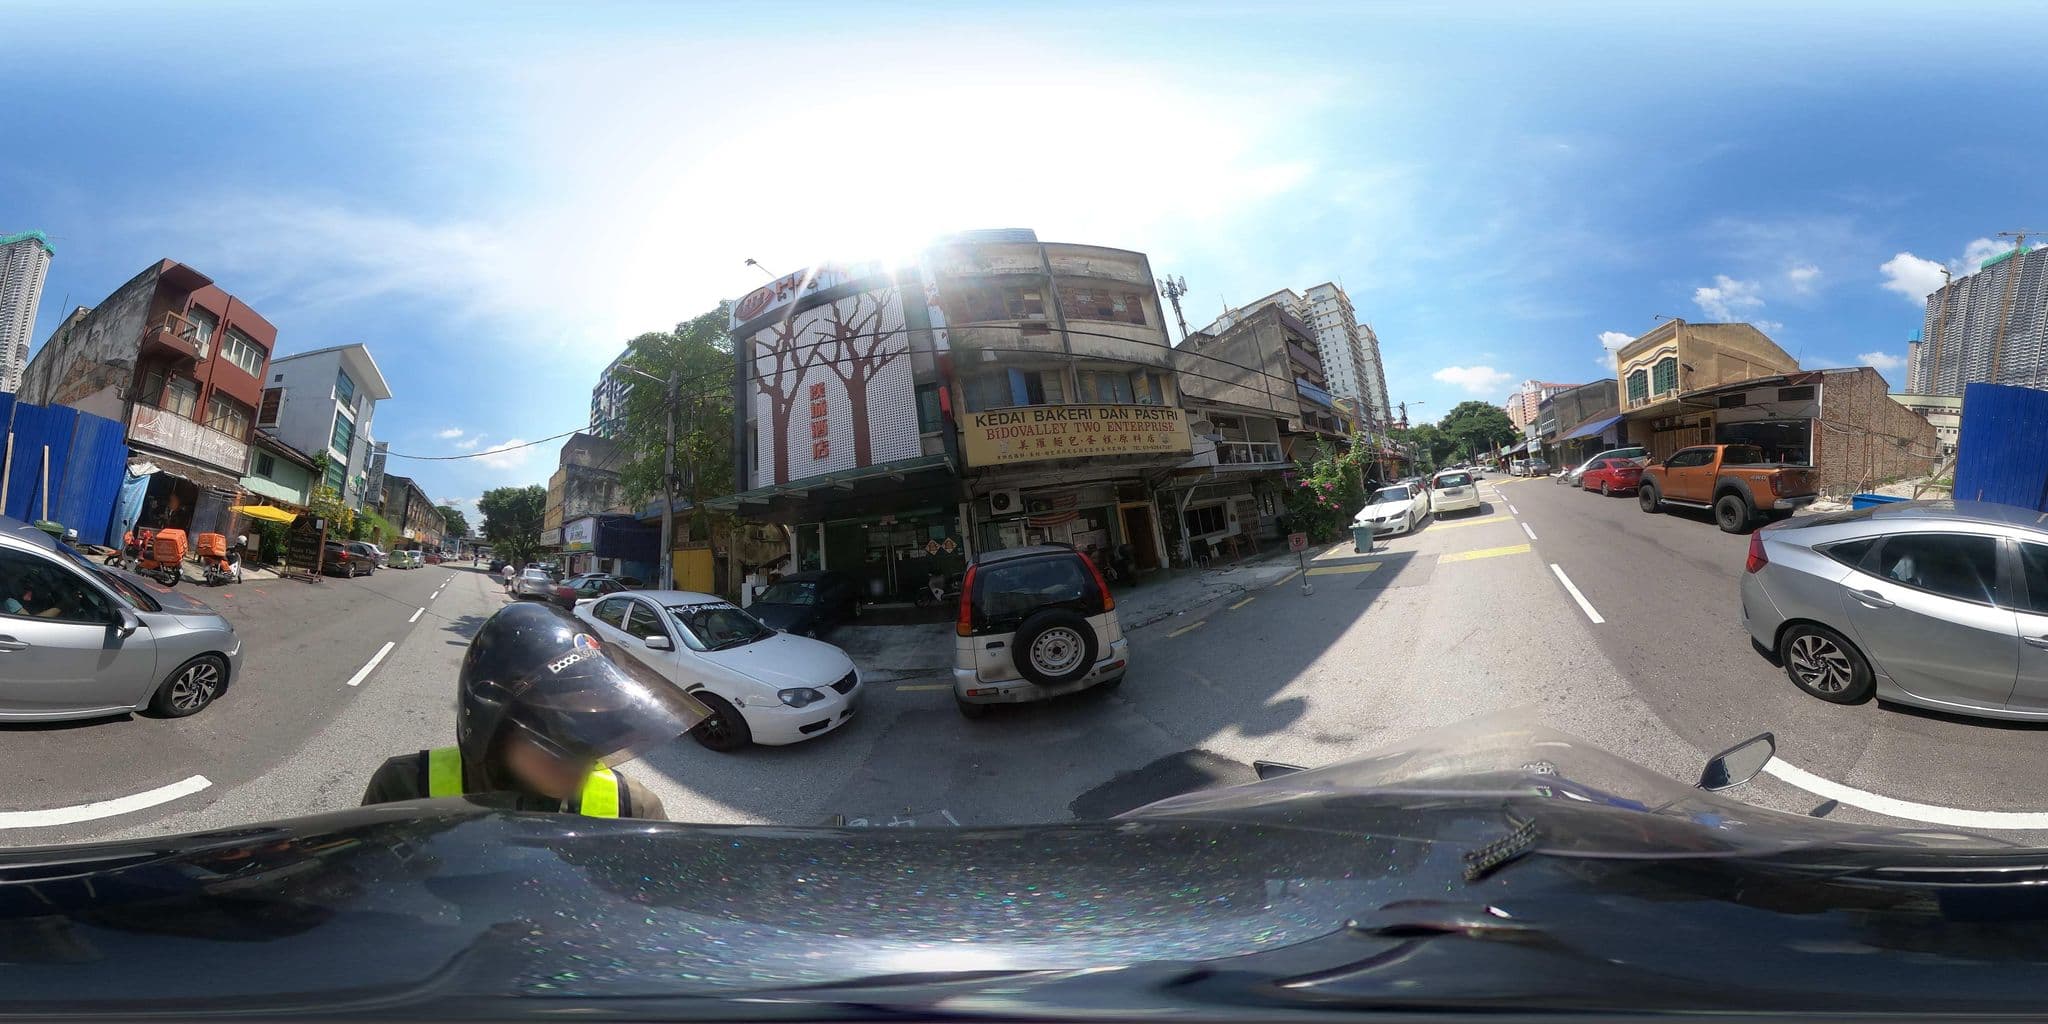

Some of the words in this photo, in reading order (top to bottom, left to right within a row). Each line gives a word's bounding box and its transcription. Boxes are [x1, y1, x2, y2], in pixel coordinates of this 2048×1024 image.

[976, 411, 1026, 428] KEDAI
[1034, 408, 1092, 422] BAKERI
[1100, 408, 1128, 420] DAN
[1135, 408, 1178, 421] PASTRI
[1074, 421, 1101, 433] TWO
[1107, 421, 1175, 432] ENTERPRISE
